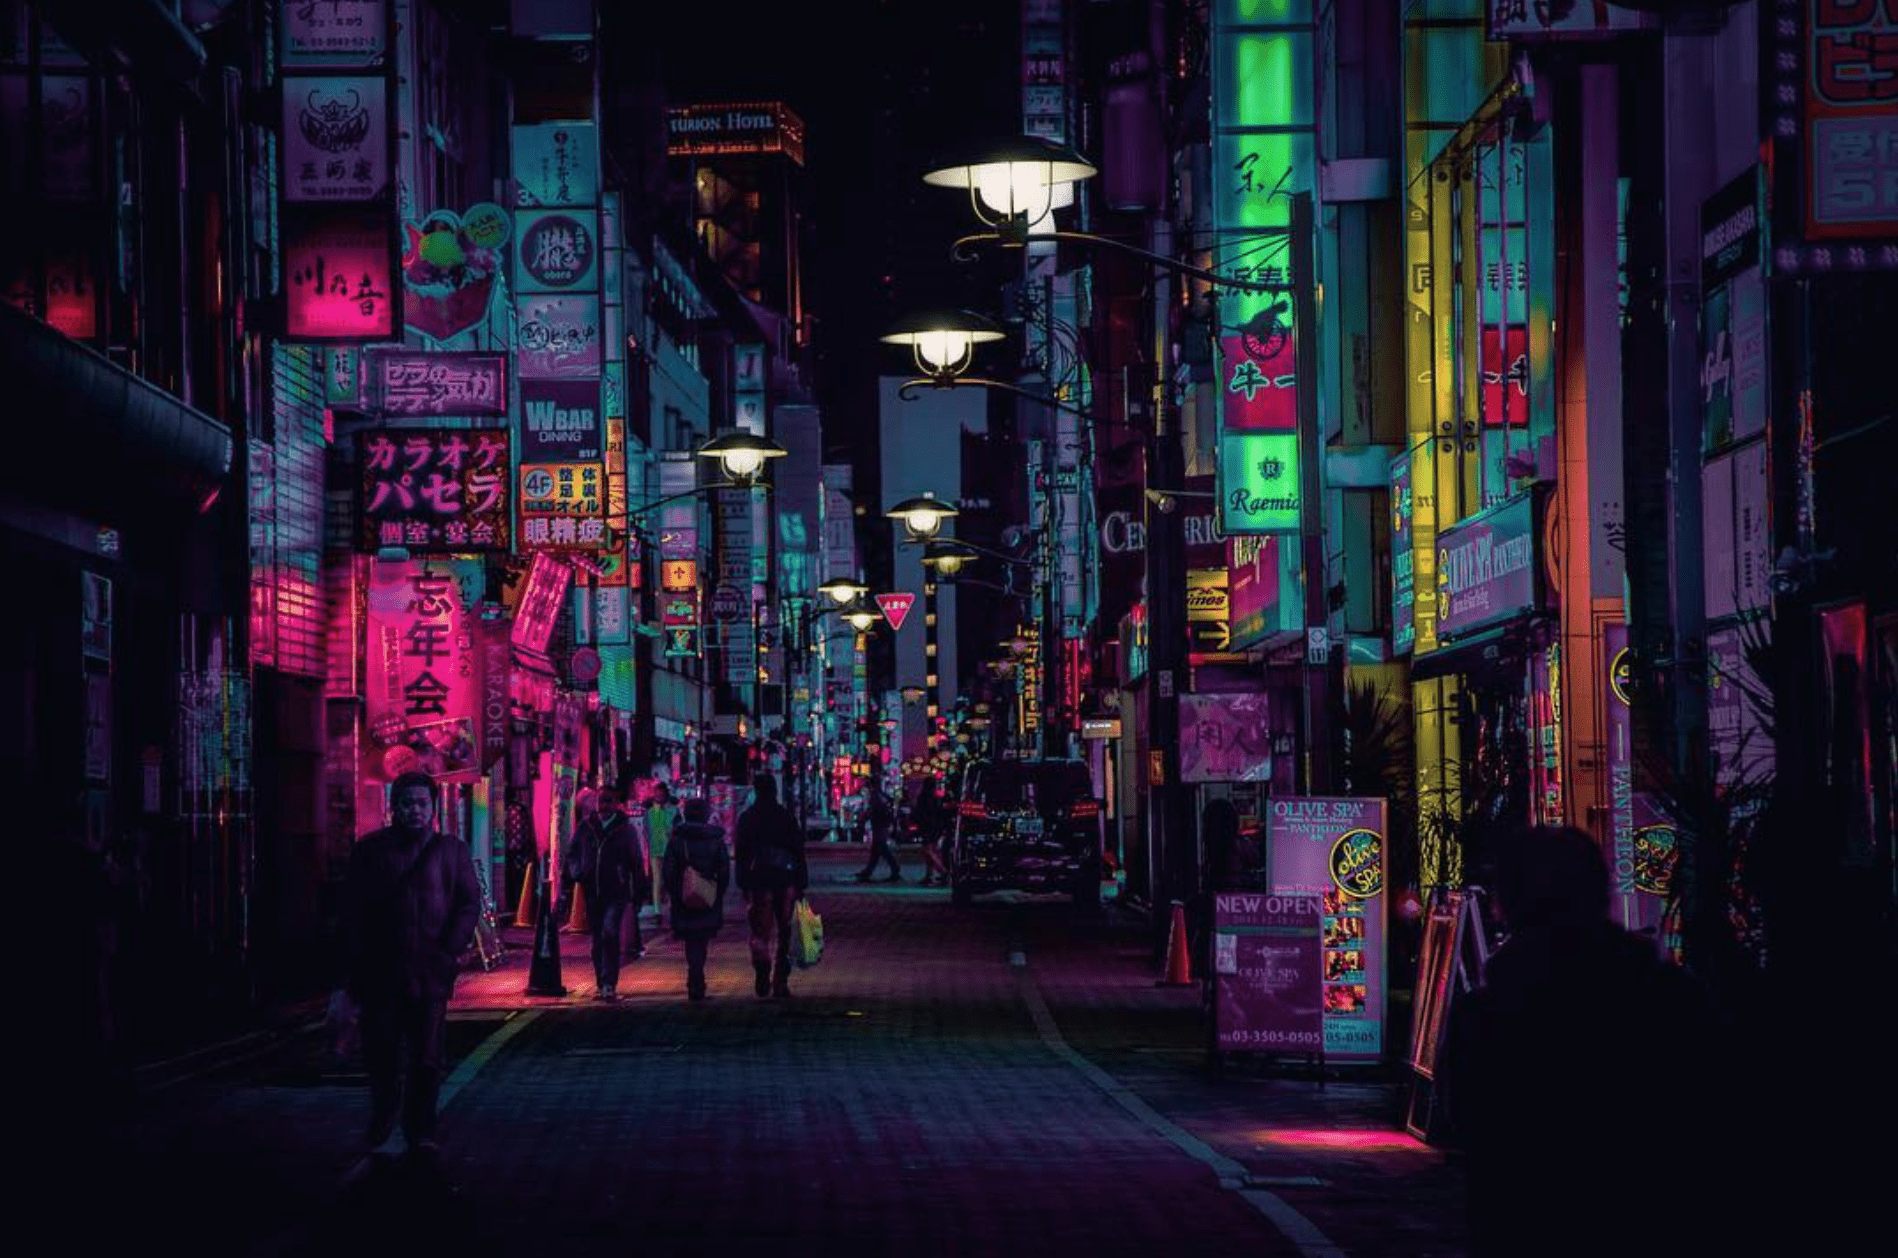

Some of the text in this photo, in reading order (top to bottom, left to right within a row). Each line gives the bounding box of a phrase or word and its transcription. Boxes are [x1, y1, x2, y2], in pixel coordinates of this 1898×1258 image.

[538, 431, 583, 443] DINING
[368, 436, 506, 471] カラオケ
[366, 473, 501, 514] パセラ
[526, 474, 550, 494] 4F
[557, 499, 599, 513] オイル
[403, 568, 453, 716] 忘年会
[486, 645, 505, 747] KARAOKE
[1274, 801, 1363, 817] OLIVE SPA
[1215, 897, 1320, 915] NEW OPEN
[1232, 1030, 1321, 1044] 03-3505-0505
